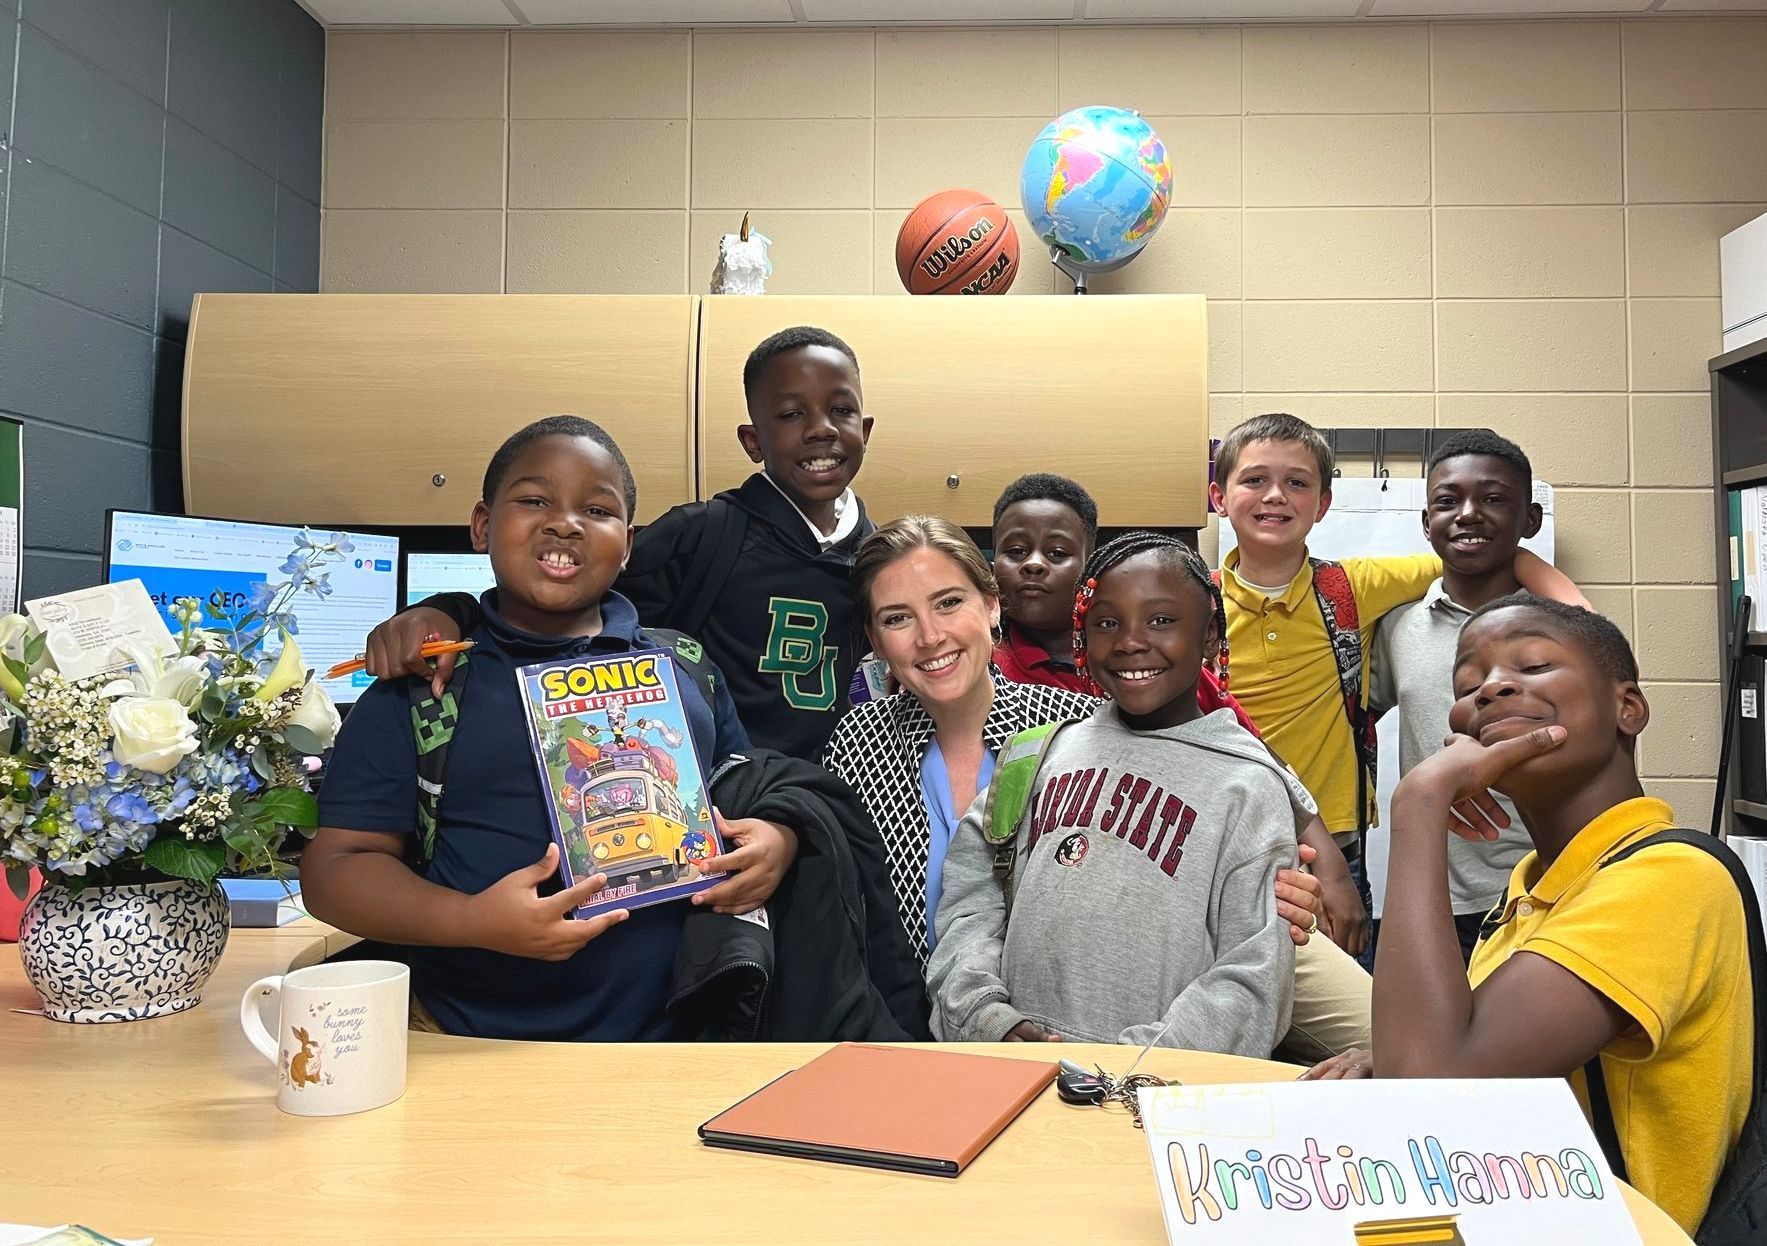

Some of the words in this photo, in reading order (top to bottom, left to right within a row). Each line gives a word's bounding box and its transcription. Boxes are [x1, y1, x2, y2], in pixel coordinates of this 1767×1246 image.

[921, 218, 995, 278] Wilson
[758, 597, 838, 711] BU
[541, 658, 661, 701] SONIC
[547, 701, 578, 716] THE
[1100, 772, 1198, 878] STATE
[605, 888, 617, 900] BY
[618, 883, 637, 897] FIRE
[337, 1005, 368, 1016] some
[323, 1014, 365, 1031] bunny
[331, 1028, 362, 1043] loves
[334, 1045, 360, 1059] you
[1167, 1136, 1406, 1225] Kristin
[1407, 1135, 1604, 1208] Hanna
